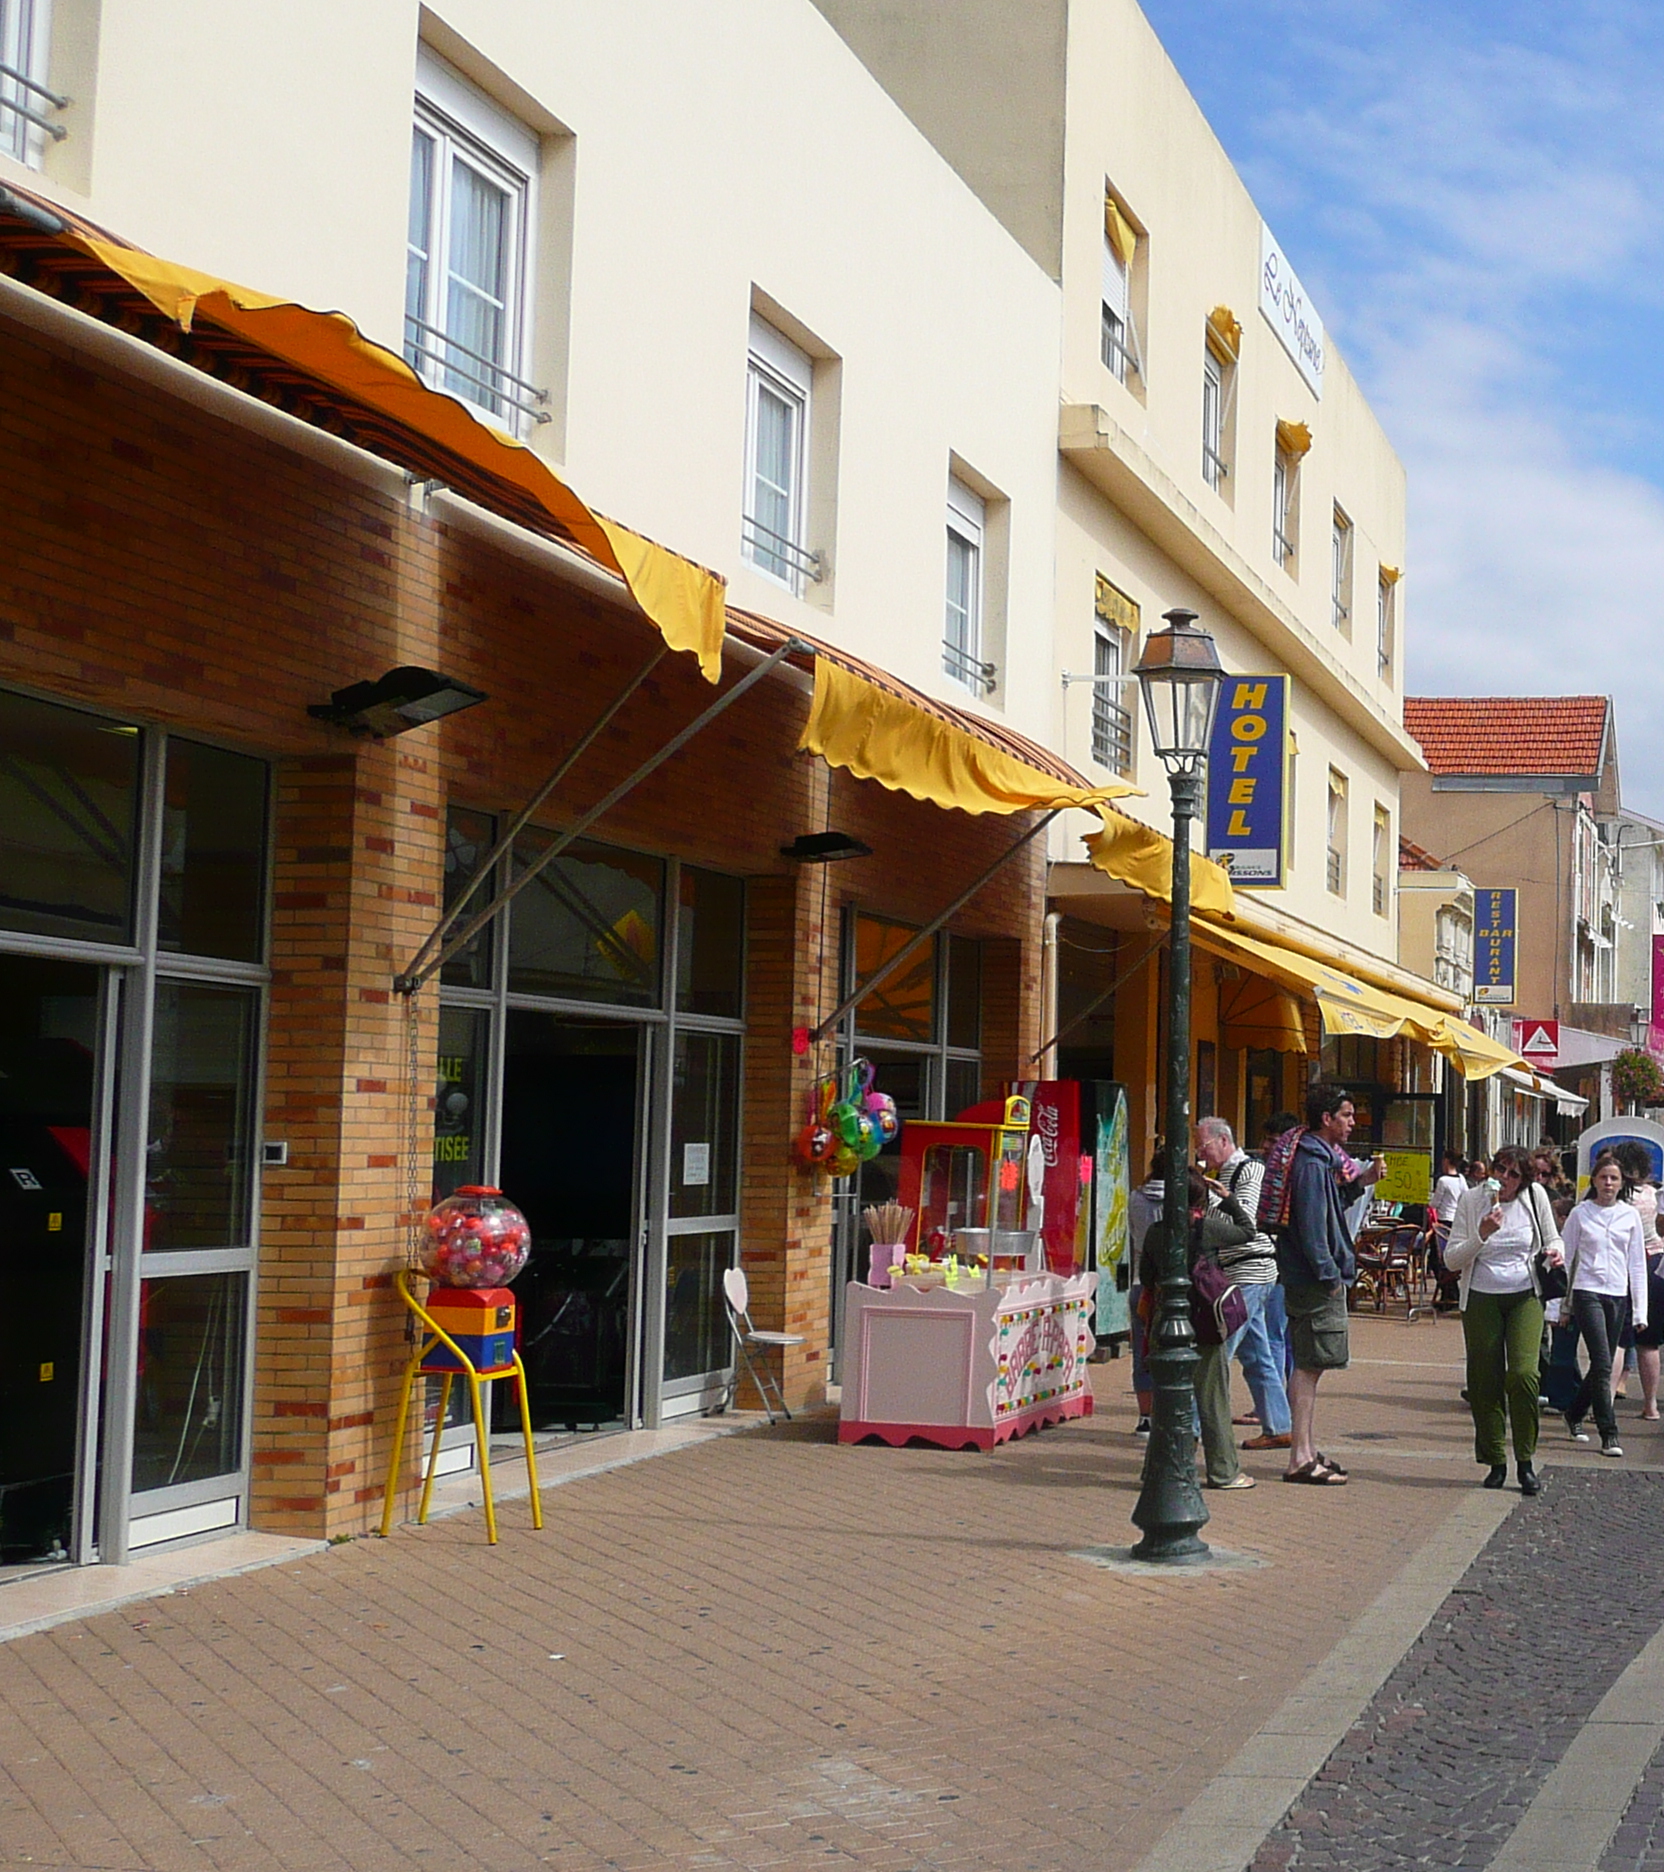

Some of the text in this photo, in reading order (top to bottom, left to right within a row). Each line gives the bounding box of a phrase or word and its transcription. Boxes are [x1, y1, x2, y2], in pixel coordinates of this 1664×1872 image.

[1227, 683, 1268, 836] HOTEL
[1479, 929, 1513, 938] BAR
[1489, 891, 1501, 985] RESTAURANT
